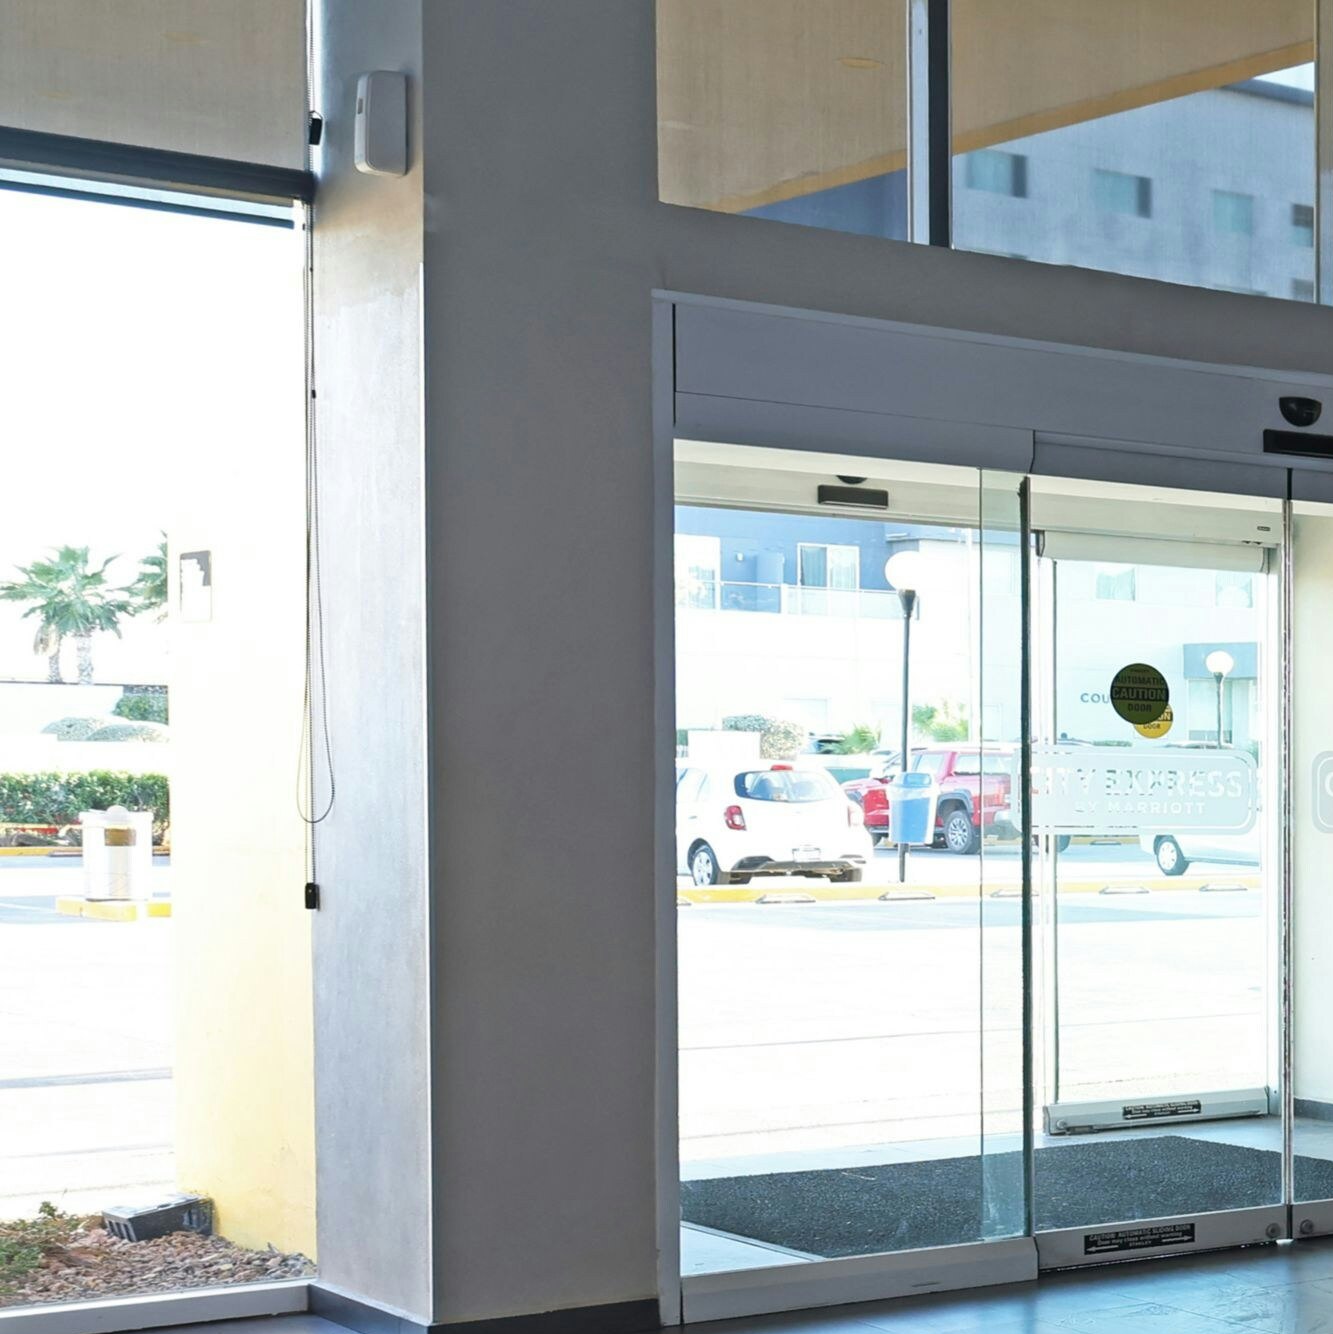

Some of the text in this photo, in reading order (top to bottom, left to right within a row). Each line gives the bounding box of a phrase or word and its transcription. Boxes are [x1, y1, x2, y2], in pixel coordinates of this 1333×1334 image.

[1112, 687, 1166, 701] CAUTION
[1127, 703, 1152, 713] DOOR
[1105, 768, 1243, 798] EXPRESS
[1107, 801, 1206, 815] MARRIOTT
